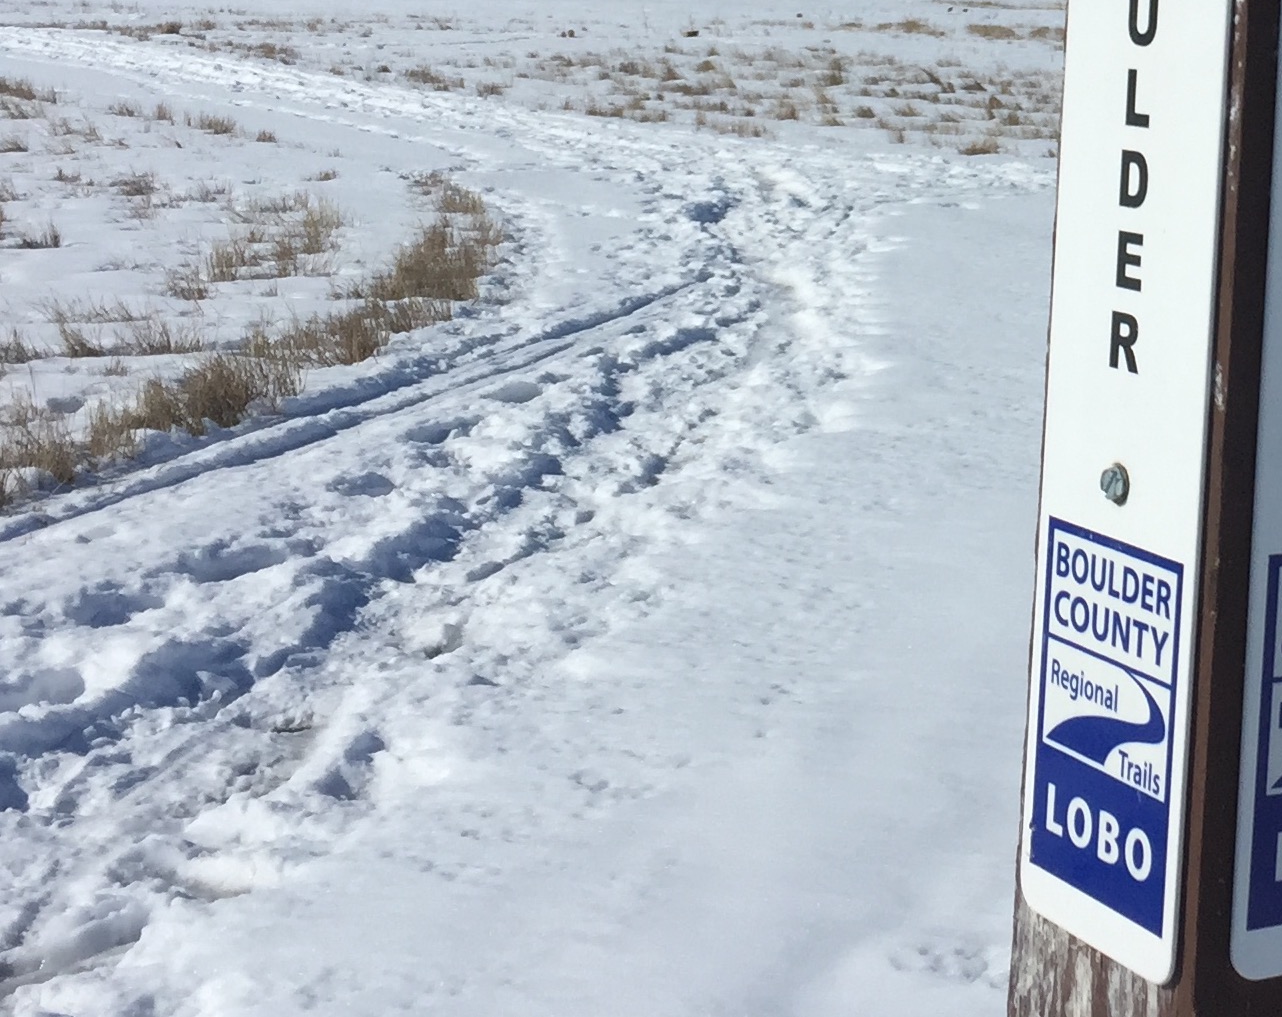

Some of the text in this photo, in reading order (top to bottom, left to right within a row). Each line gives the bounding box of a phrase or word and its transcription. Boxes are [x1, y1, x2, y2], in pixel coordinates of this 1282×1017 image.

[1055, 541, 1172, 620] BOULDER
[1053, 590, 1169, 668] COUNTY
[1050, 658, 1118, 713] Regional
[1118, 749, 1161, 795] Trails
[1045, 782, 1153, 882] LOBO
